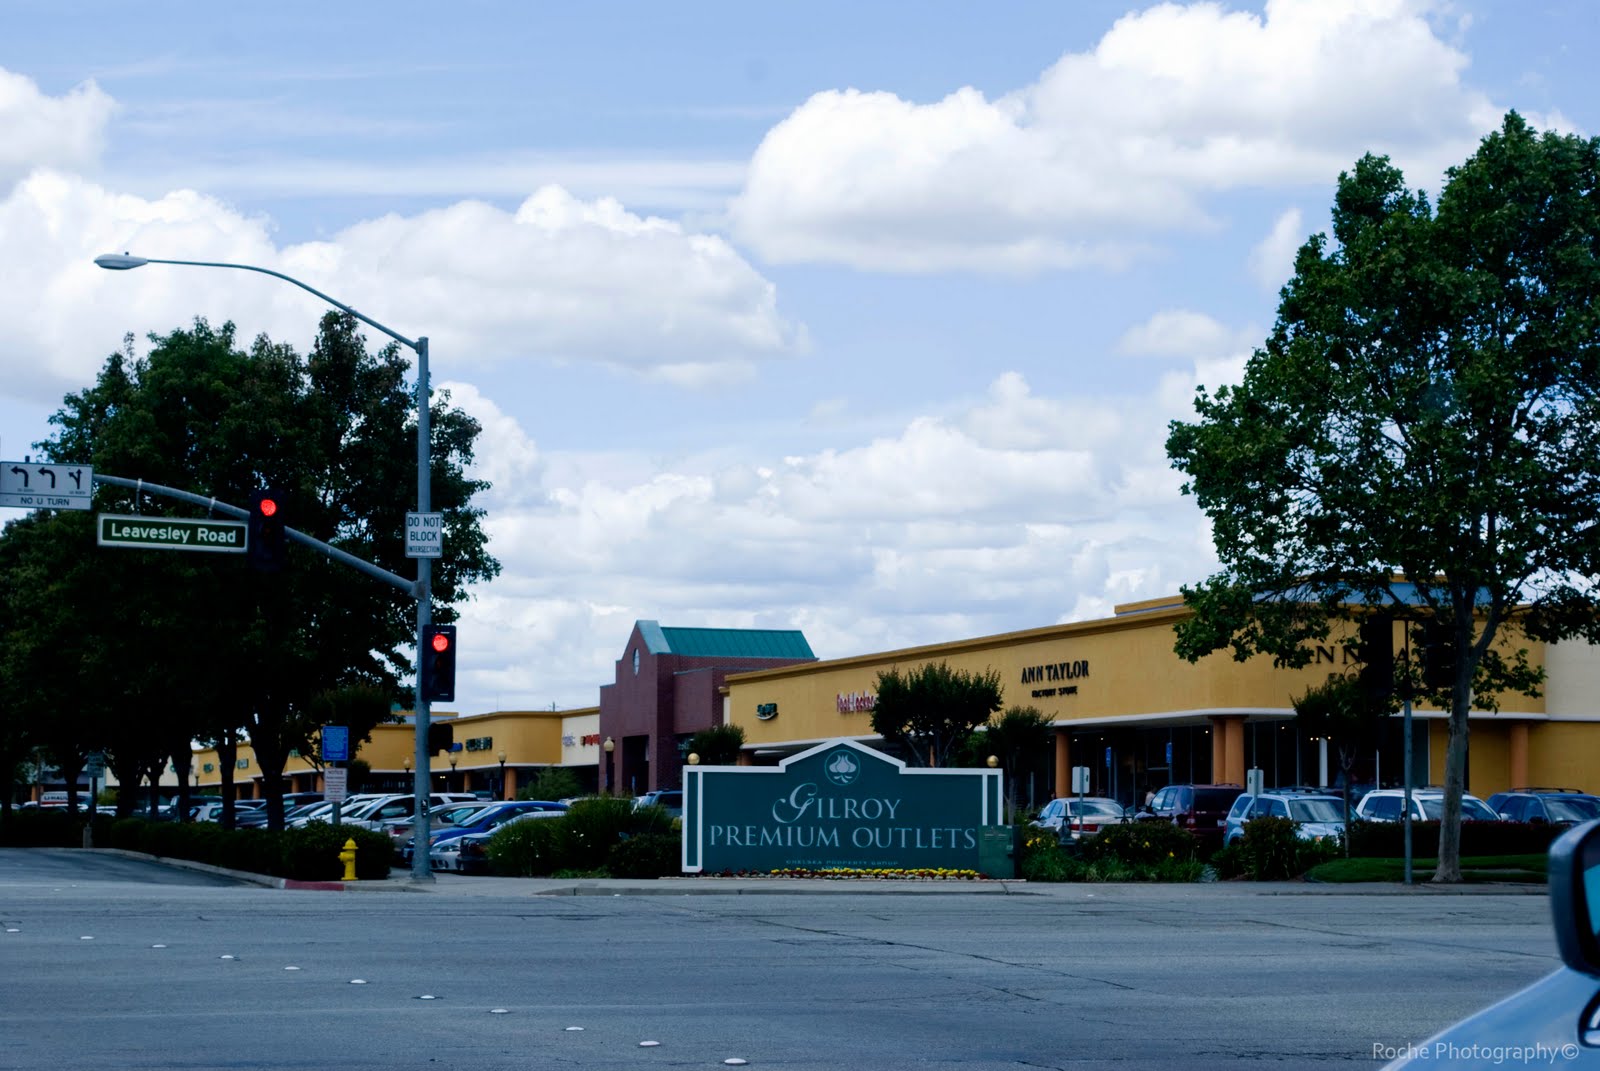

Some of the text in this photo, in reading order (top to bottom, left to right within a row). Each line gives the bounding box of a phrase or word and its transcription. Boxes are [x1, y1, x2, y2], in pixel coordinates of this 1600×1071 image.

[20, 496, 33, 505] NO
[47, 498, 70, 506] TURN
[408, 516, 440, 527] DO NOT
[111, 523, 237, 544] Leavesley Road
[410, 531, 437, 541] BLOCK
[1021, 660, 1089, 684] ANN TAYLOR
[772, 783, 901, 823] GILROY
[710, 825, 976, 849] PREMIUM OUTLETS
